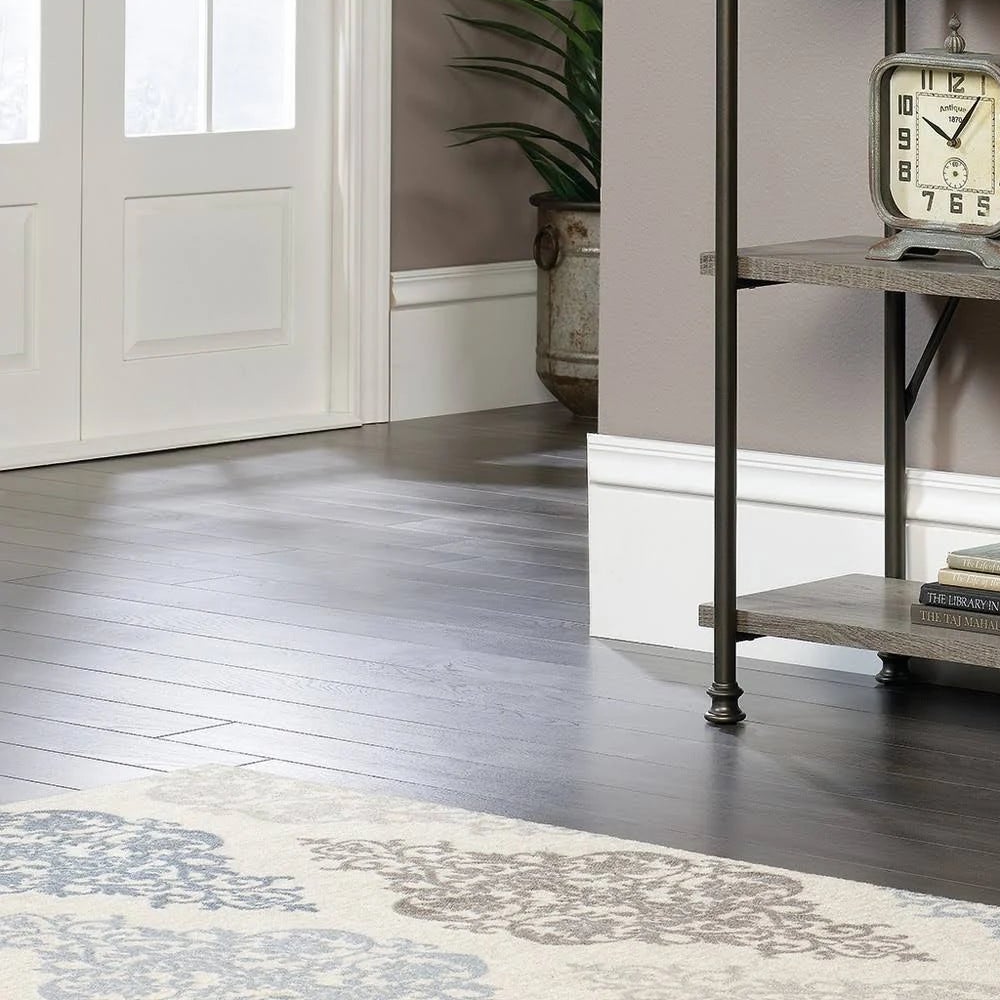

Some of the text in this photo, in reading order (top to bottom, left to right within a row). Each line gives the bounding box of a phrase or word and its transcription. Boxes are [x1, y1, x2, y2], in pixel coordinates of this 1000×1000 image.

[921, 69, 933, 90] 11
[948, 71, 965, 93] 12
[898, 94, 913, 116] 10
[898, 127, 911, 150] 9
[898, 160, 911, 182] 8
[922, 190, 934, 211] 7
[950, 193, 963, 214] 6
[977, 195, 990, 217] 5
[928, 592, 946, 605] THE
[948, 595, 987, 610] LIBRARY
[988, 601, 999, 611] IN
[920, 610, 942, 623] THE
[944, 613, 961, 627] TAJ
